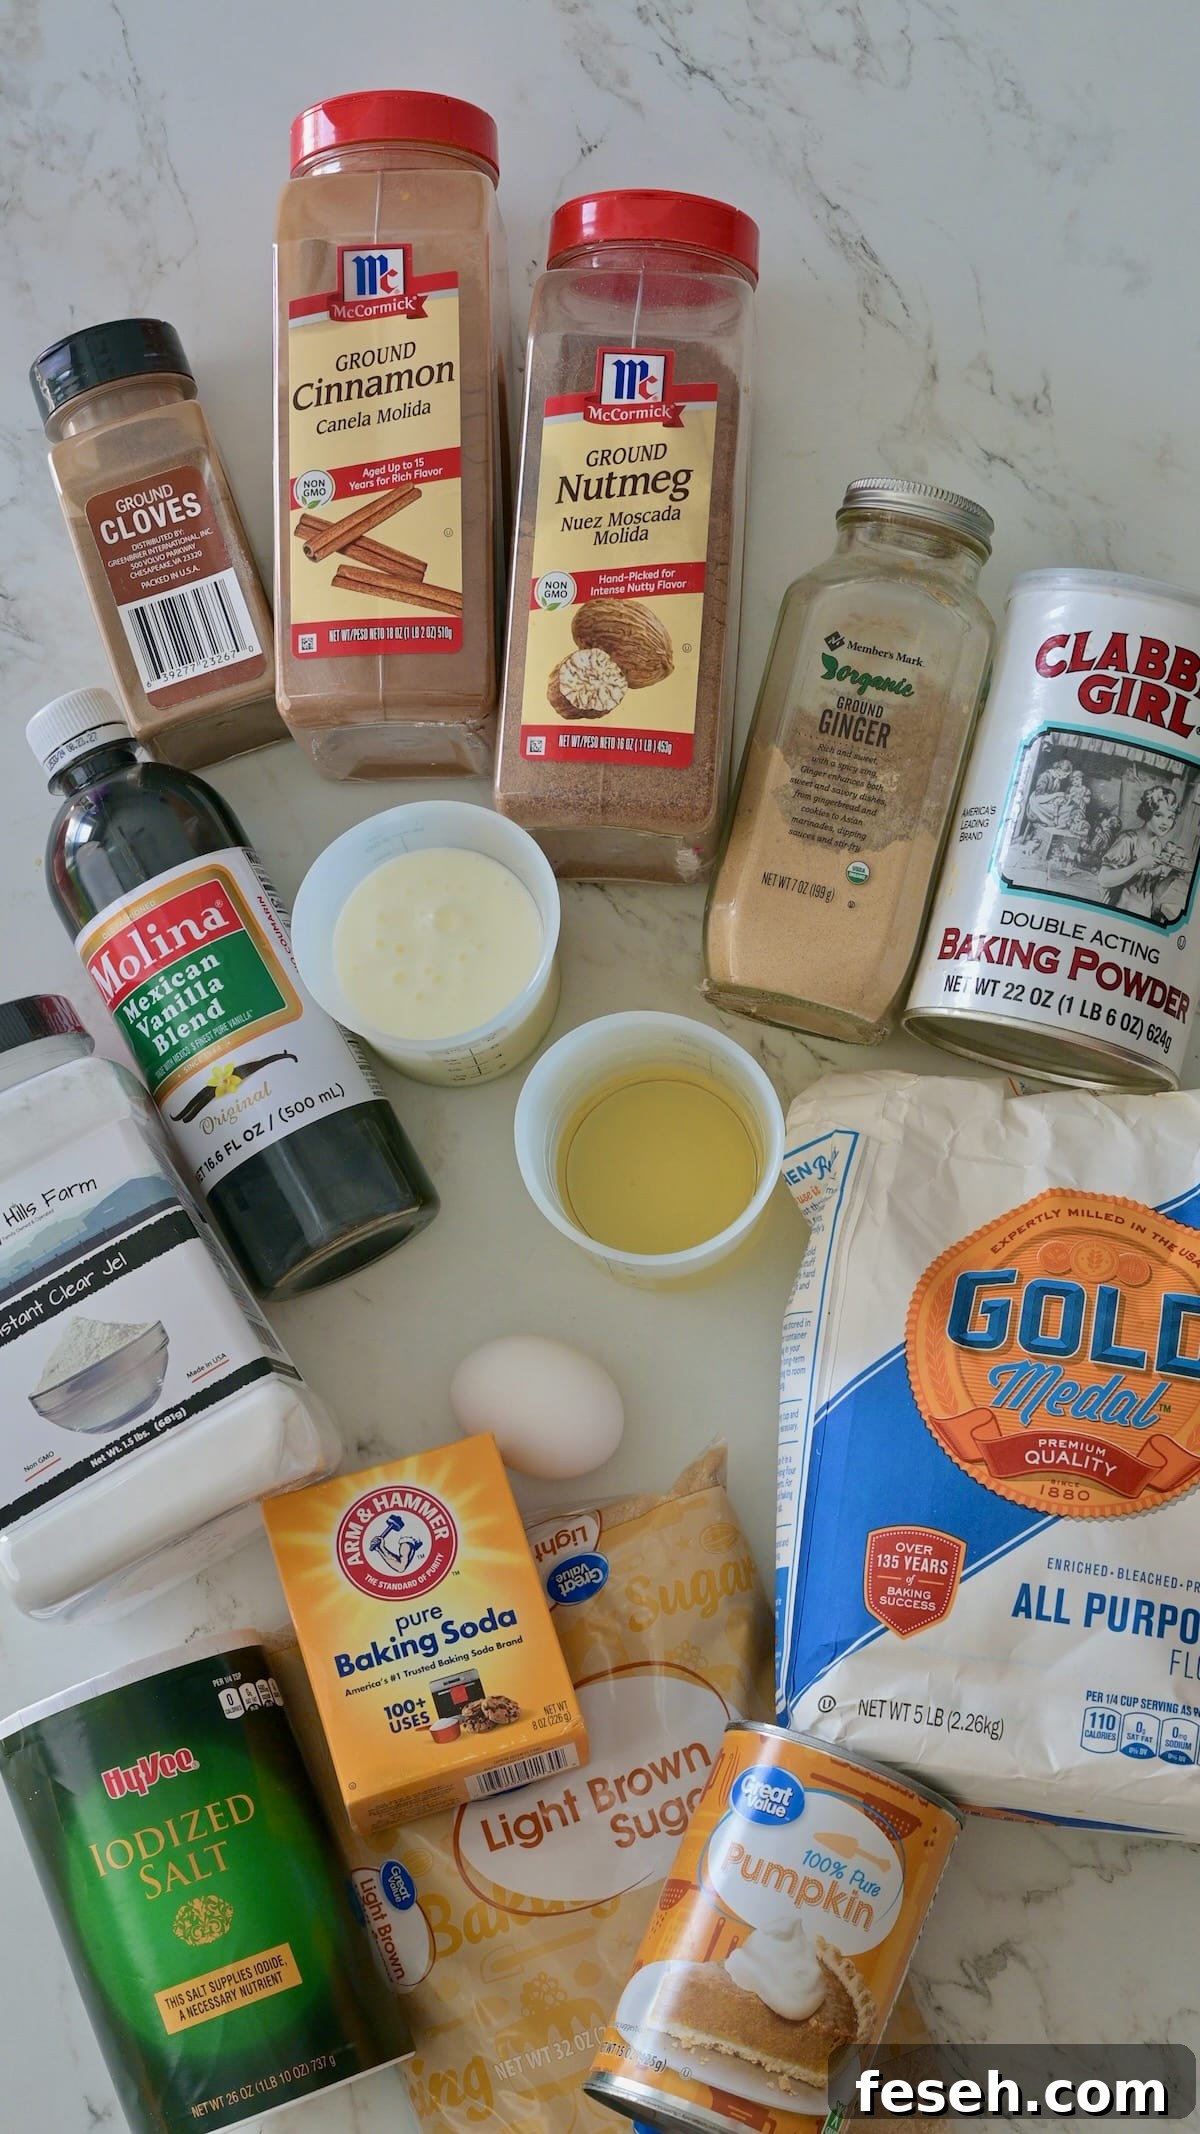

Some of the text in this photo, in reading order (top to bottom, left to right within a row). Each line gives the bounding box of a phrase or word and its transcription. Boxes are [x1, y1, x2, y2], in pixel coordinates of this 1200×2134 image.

[332, 295, 416, 318] McCormick
[336, 341, 416, 372] GROUND
[292, 361, 455, 411] Cinnamon
[316, 400, 431, 435] Canela Molida
[587, 404, 672, 422] McCormick
[363, 458, 425, 478] Aged Up to 15
[586, 443, 667, 467] GROUND
[303, 479, 326, 488] NON
[303, 488, 326, 497] GMO
[349, 466, 443, 491] Years for Rich Flavor
[555, 468, 694, 504] Nutmeg
[116, 484, 173, 513] GROUND
[100, 492, 202, 545] CLOVES
[561, 505, 681, 532] Nuez Moscada
[131, 529, 184, 551] DISTRIBUTED BY:
[593, 526, 649, 546] Molida
[130, 543, 196, 570] 500 VOLVO PARKWAY
[140, 565, 200, 590] PACKED IN U.S.A.
[545, 581, 568, 589] NON
[591, 580, 687, 596] Intense Nutty Flavor
[599, 568, 676, 584] Hand-Picked for
[544, 590, 568, 599] GMO
[846, 641, 924, 667] Member's Mark
[1035, 631, 1200, 699] CLABB
[836, 665, 915, 697] organic
[837, 696, 884, 718] GROUND
[1078, 674, 1196, 739] GIRL
[819, 709, 891, 748] GINGER
[960, 819, 990, 830] LEADING
[960, 832, 983, 842] BRAND
[761, 872, 835, 903] NET WT 7 OZ (199 g)
[1000, 910, 1160, 964] DOUBLE ACTING
[91, 905, 230, 1007] Molina
[123, 953, 221, 1024] Mexican
[938, 928, 1190, 1024] BAKING POWDER
[136, 976, 225, 1038] Vanilla
[944, 975, 1172, 1054] NET WT 22 OZ (1 LB 6 OZ) 624g
[152, 998, 226, 1057] Blend
[199, 1081, 272, 1136] Original
[205, 1150, 224, 1173] 16.6
[224, 1139, 242, 1158] FL
[243, 1122, 265, 1143] OZ
[278, 1097, 315, 1123] (500
[318, 1082, 345, 1104] mL)
[3, 1178, 98, 1227] Hills Farm
[990, 1208, 1061, 1254] EXPERTLY
[1068, 1208, 1125, 1224] MILLED
[1130, 1221, 1147, 1234] IN
[1152, 1231, 1177, 1253] THE
[48, 1272, 95, 1306] Clear
[102, 1251, 128, 1275] Jel
[186, 1365, 205, 1379] Made
[213, 1353, 227, 1365] USA
[987, 1359, 1172, 1429] Medal
[90, 1407, 187, 1468] Net Wt. 1.5 lbs. (681g)
[1038, 1438, 1107, 1457] PREMIUM
[1024, 1450, 1118, 1477] QUALITY
[1040, 1484, 1090, 1501] 1880
[344, 1492, 450, 1566] ARM & HAMMER
[534, 1525, 588, 1562] Light
[877, 1554, 949, 1575] 135 YEARS
[895, 1542, 933, 1556] OVER
[365, 1553, 444, 1591] THE STANDARD OF PURITY
[905, 1574, 916, 1586] of
[1047, 1557, 1178, 1589] ENRICHED BLEACHED
[879, 1596, 936, 1611] SUCCESS
[887, 1586, 932, 1600] BAKING
[395, 1606, 443, 1637] pure
[1011, 1582, 1200, 1645] ALL PURPO
[334, 1607, 518, 1678] Baking Soda
[344, 1635, 524, 1697] America's #1 Trusted Baking Soda Brand
[383, 1698, 426, 1720] 100+
[389, 1711, 430, 1734] USES
[858, 1699, 1004, 1741] NET WT 5 LB (2.26kg)
[480, 1787, 581, 1852] Light
[586, 1741, 712, 1815] Brown
[741, 1774, 793, 1806] Great
[744, 1793, 786, 1818] Value
[88, 1794, 255, 1878] IODIZED
[139, 1840, 229, 1900] SALT
[801, 1849, 881, 1897] 100% Pure
[721, 1842, 875, 1933] Pumpkin
[359, 1877, 406, 1981] Light Brown
[164, 1954, 288, 2010] THIS SALT SUPPLIES IODIDE,
[179, 1971, 284, 2022] A NECESSARY NUTRIENT
